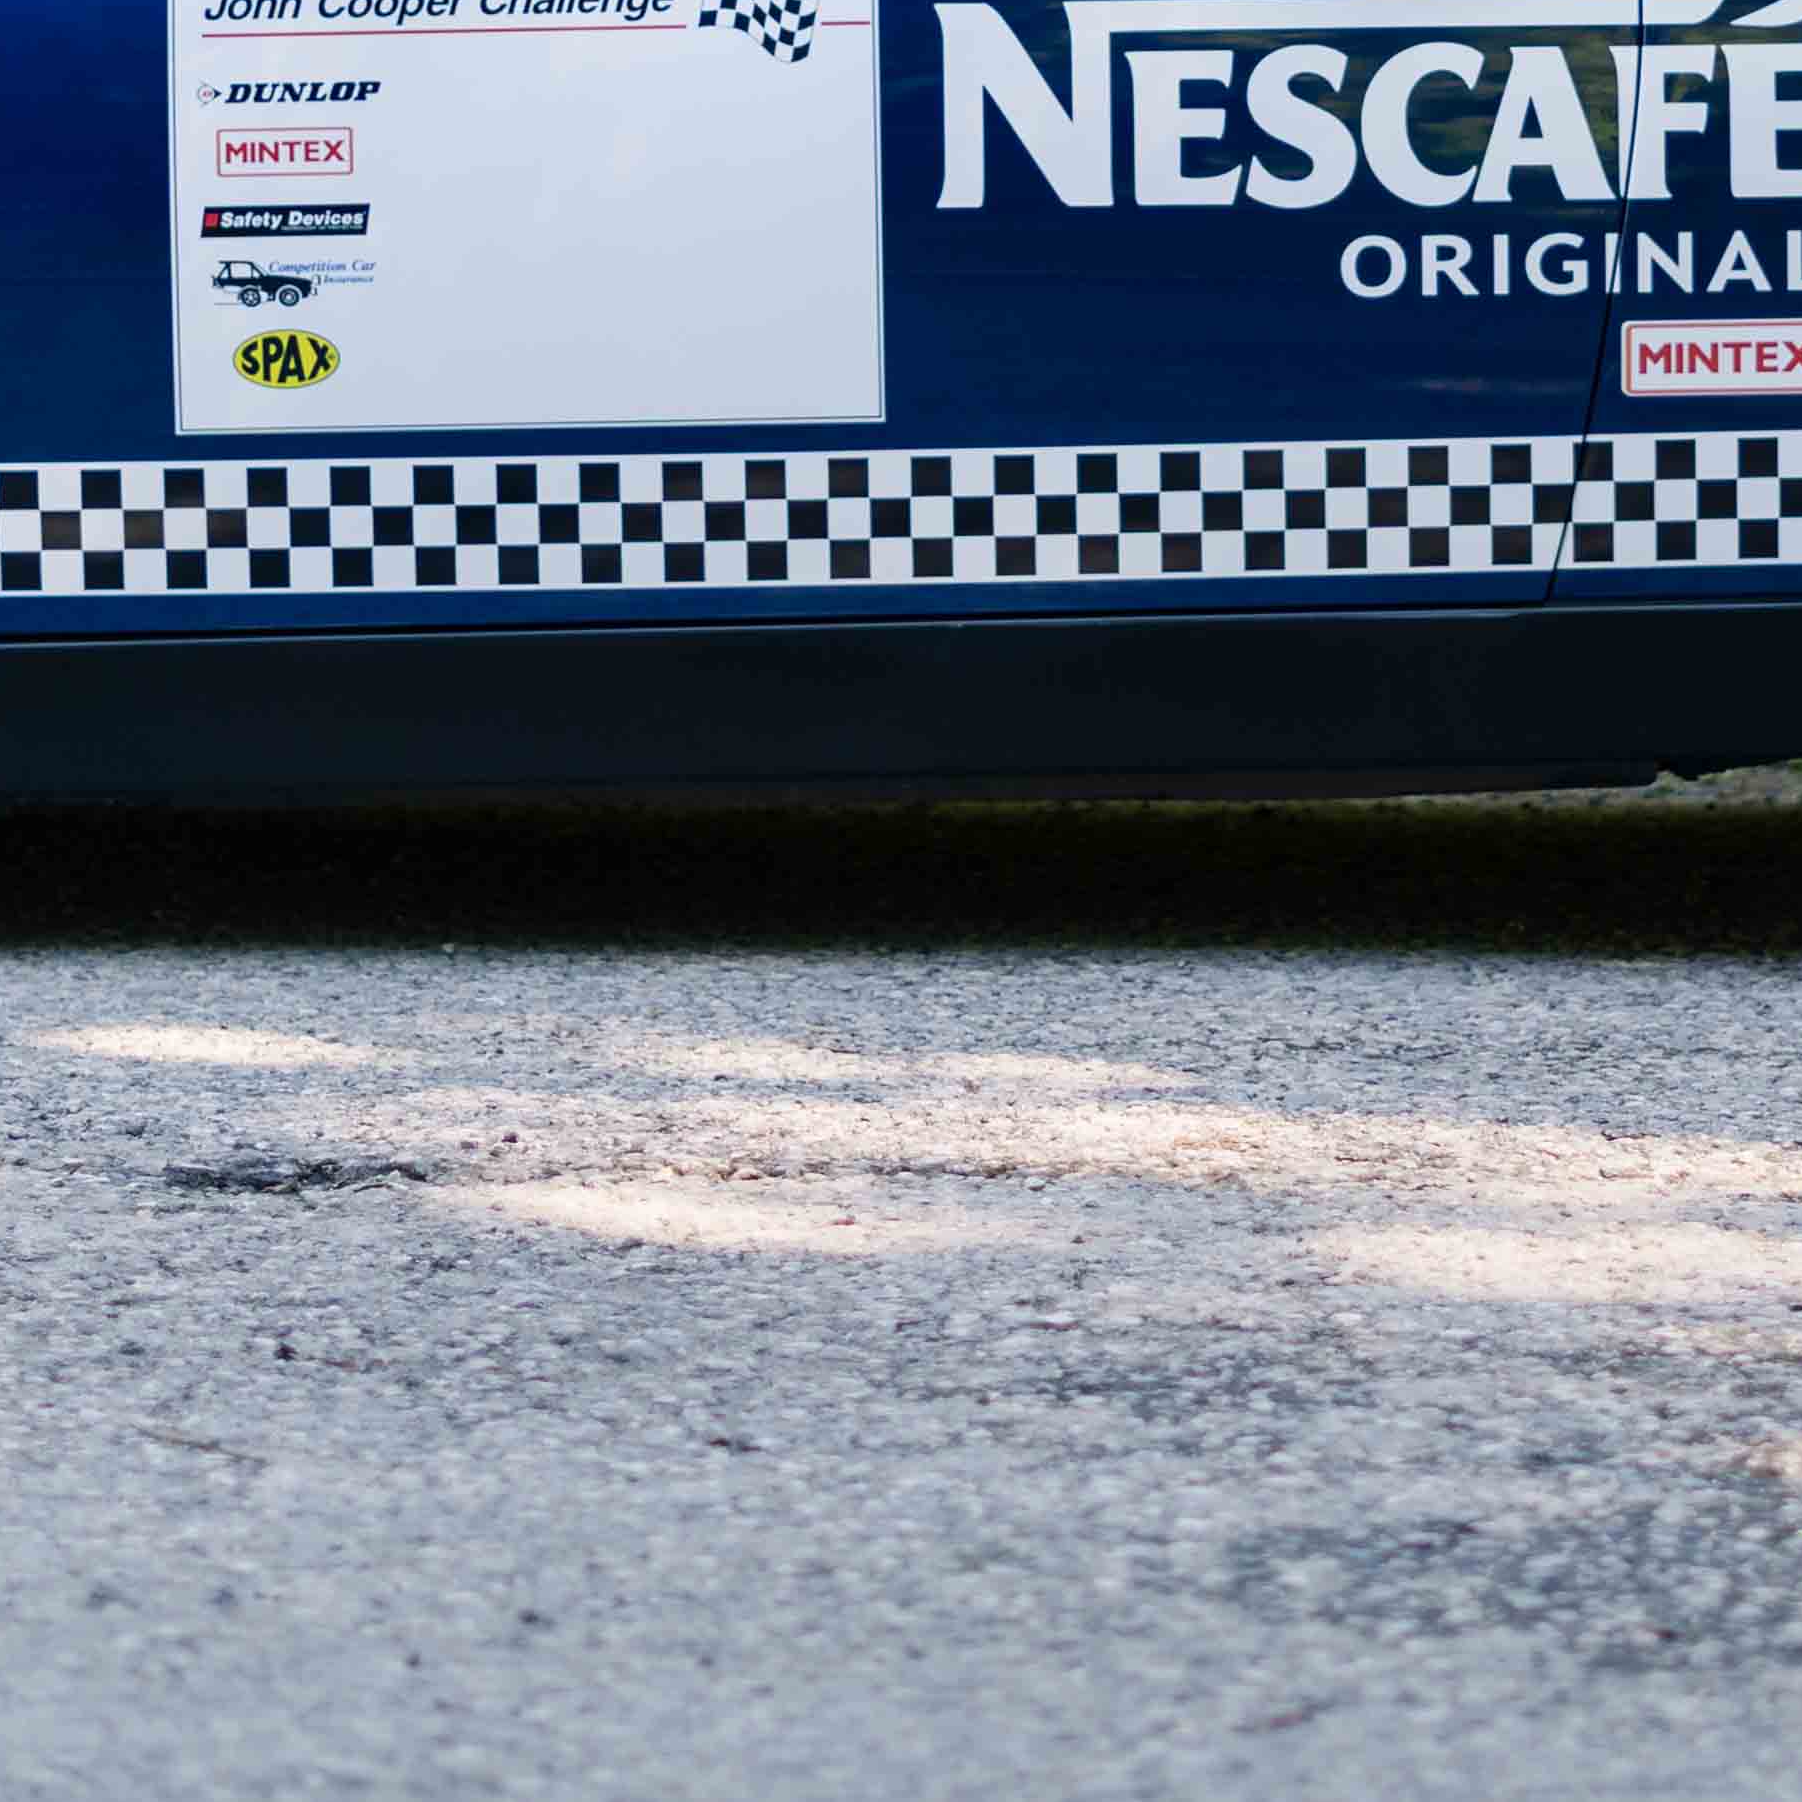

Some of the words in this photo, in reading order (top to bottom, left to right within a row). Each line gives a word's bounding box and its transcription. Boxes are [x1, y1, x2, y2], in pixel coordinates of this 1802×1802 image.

[224, 81, 382, 104] DUNLOP
[225, 140, 346, 164] MINTEX
[220, 211, 283, 230] Safety
[288, 210, 364, 227] Devices
[268, 260, 347, 274] Competition
[351, 259, 377, 272] Car
[241, 334, 332, 383] SPAX
